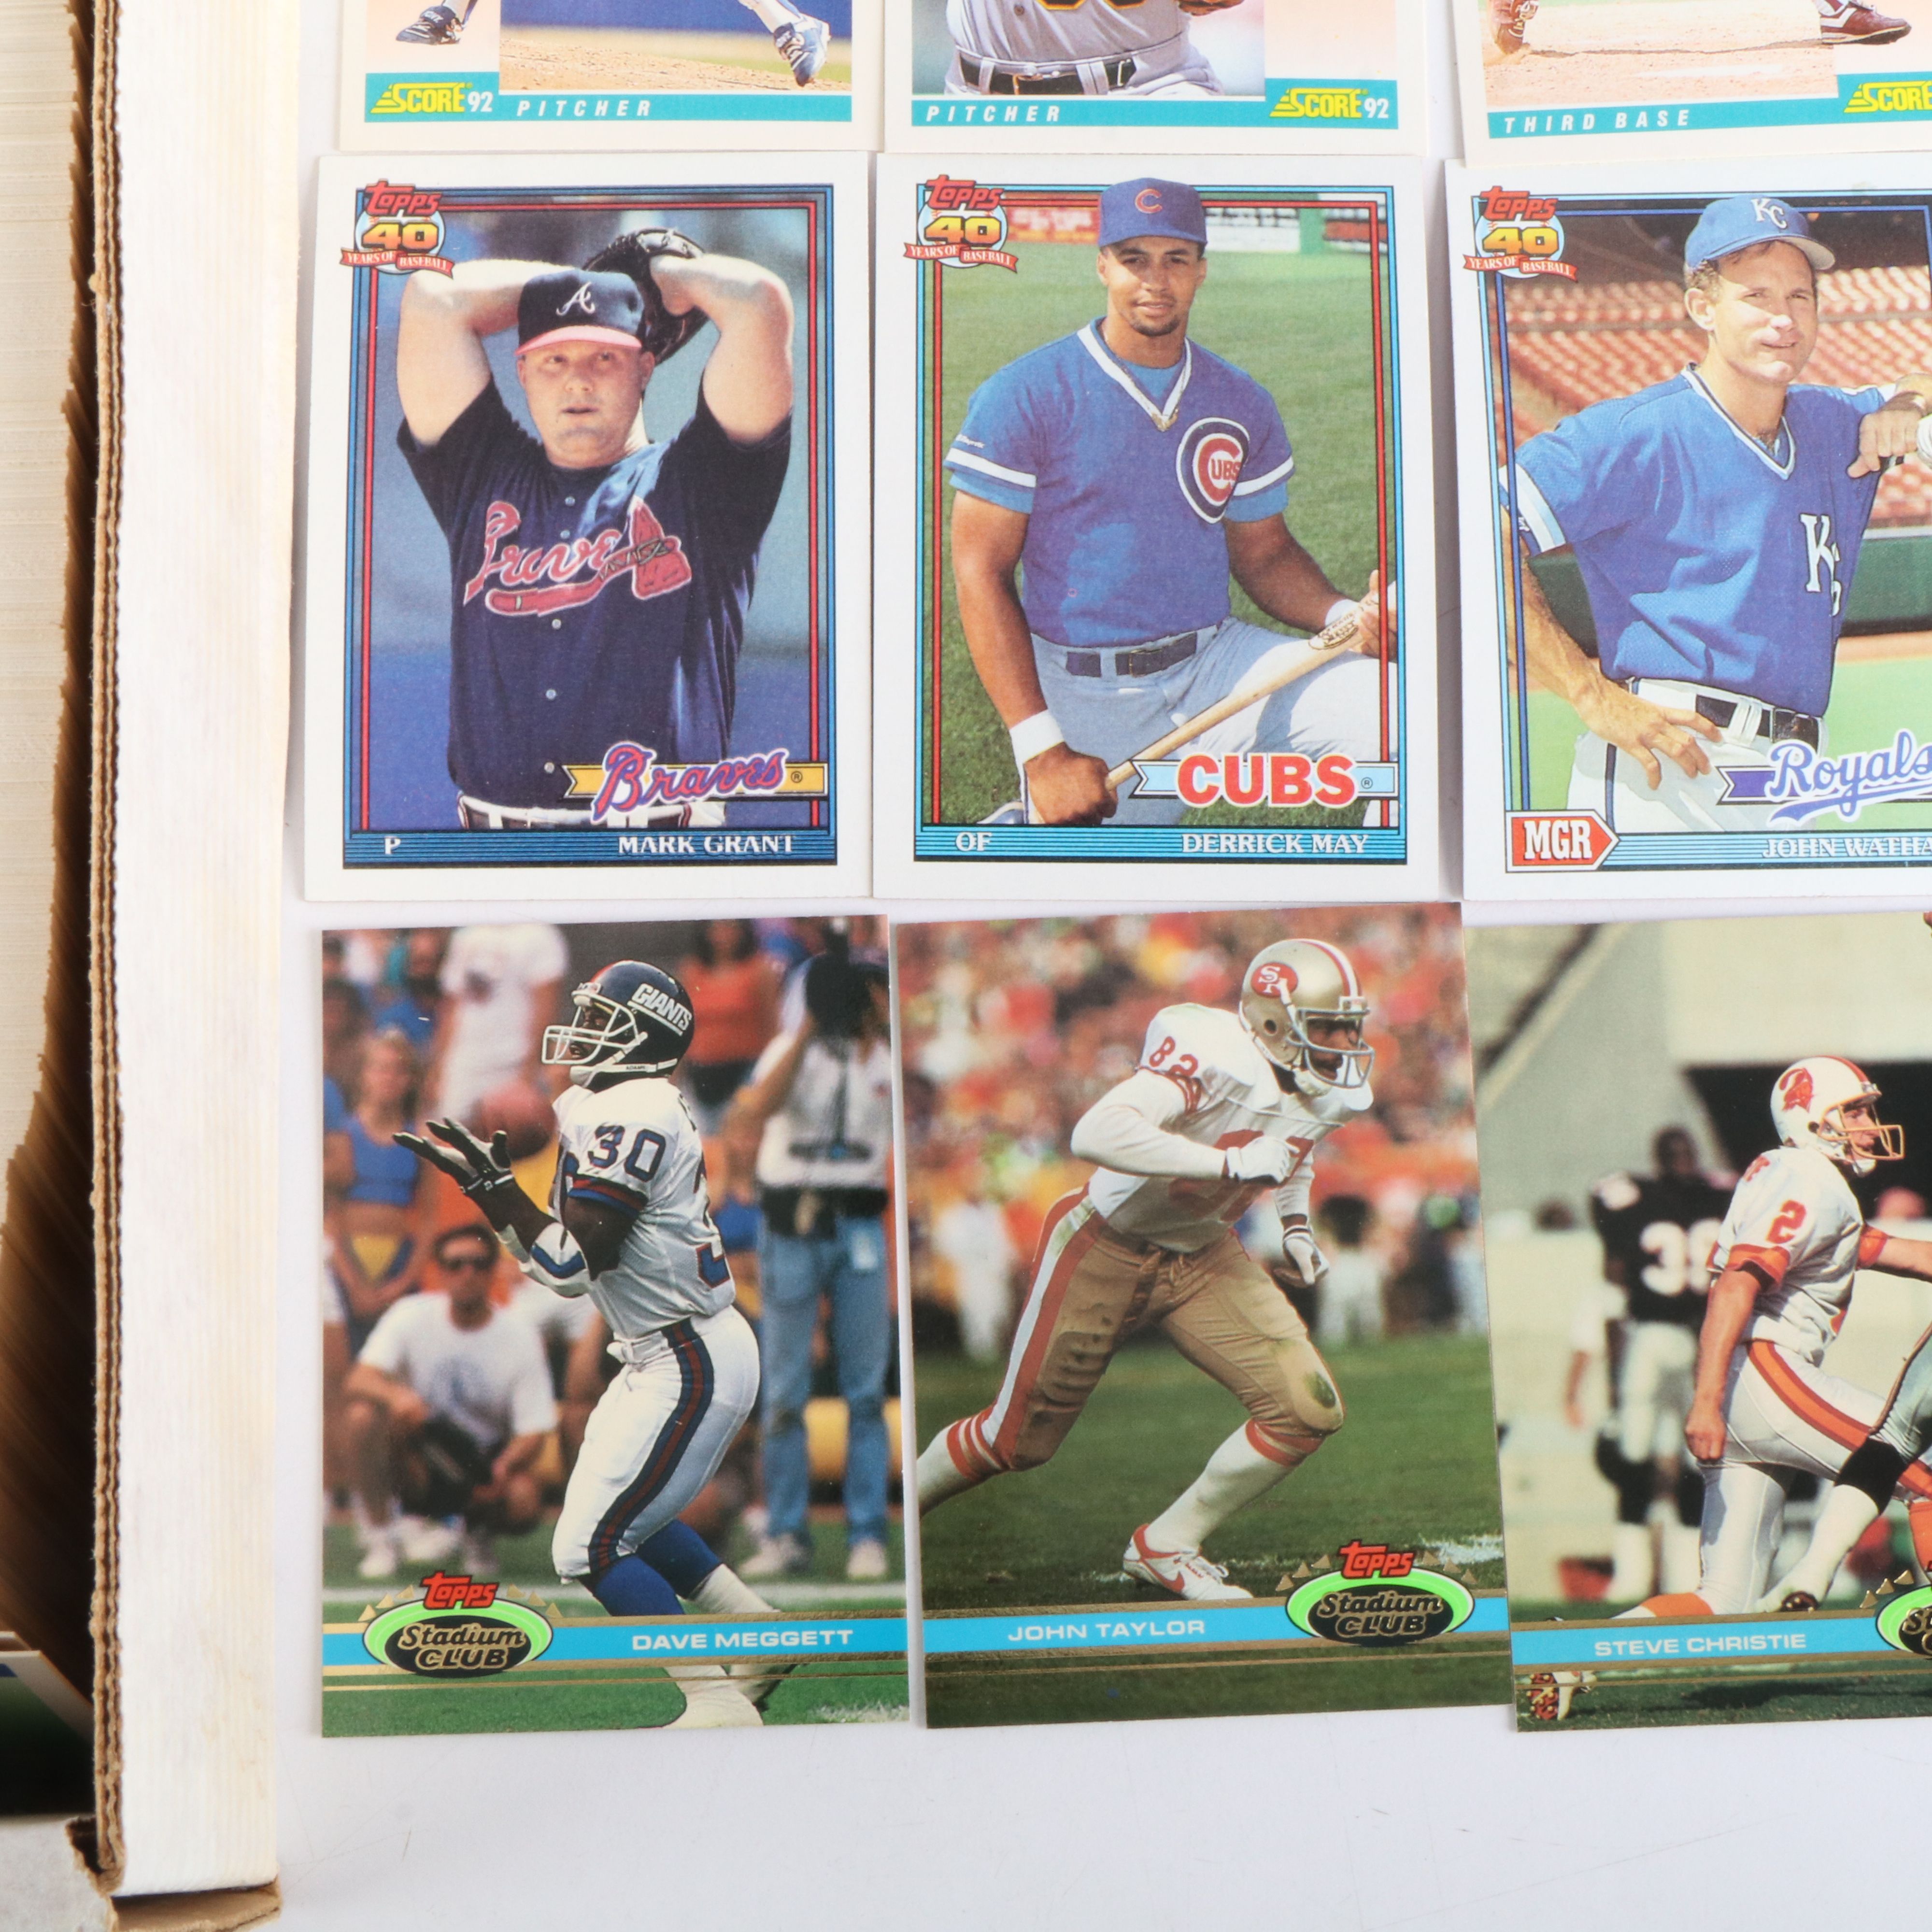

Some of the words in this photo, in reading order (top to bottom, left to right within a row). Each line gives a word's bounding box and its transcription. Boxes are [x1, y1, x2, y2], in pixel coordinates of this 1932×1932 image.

[468, 91, 493, 113] 92
[516, 100, 651, 116] PITCHER
[926, 105, 1060, 122] PITCHER
[1364, 98, 1389, 118] 92
[1505, 114, 1594, 133] THIRD
[1615, 109, 1689, 128] BASE
[1135, 188, 1163, 213] C
[1751, 198, 1787, 229] KC
[362, 222, 439, 252] 40
[924, 216, 1001, 246] 40
[1482, 227, 1559, 256] 40
[347, 252, 380, 263] YEARS
[381, 251, 395, 261] OF
[399, 257, 448, 271] BASEBALL
[910, 246, 944, 257] YEARS
[945, 245, 957, 255] OF
[963, 250, 1012, 266] BASEBALL
[1469, 258, 1503, 269] YEARS
[1504, 256, 1516, 266] OF
[1522, 261, 1571, 276] BASEBALL
[556, 281, 596, 315] A
[591, 741, 789, 824] Braves
[1176, 752, 1358, 809] CUBS
[1765, 728, 1932, 825] Royals
[384, 836, 401, 855] P
[618, 836, 695, 854] MARK
[704, 835, 795, 853] GRANT
[955, 831, 992, 852] OF
[1181, 833, 1304, 853] DERRICK
[1312, 834, 1369, 854] MAY
[1524, 820, 1592, 860] MGR
[1762, 838, 1836, 858] JOHN
[631, 983, 692, 1031] GIANTS
[1149, 1036, 1198, 1076] 82
[588, 1124, 666, 1182] 30
[1766, 1200, 1806, 1244] 2
[1317, 1591, 1443, 1617] Stadium
[398, 1622, 526, 1649] Stadium
[1008, 1624, 1087, 1641] JOHN
[1095, 1620, 1205, 1638] TAYLOR
[1335, 1615, 1426, 1638] CLUB
[632, 1634, 707, 1650] DAVE
[715, 1630, 853, 1648] MEGGETT
[1595, 1639, 1679, 1656] STEVE
[1687, 1634, 1806, 1652] CHRISTIE
[416, 1646, 509, 1670] CLUB
